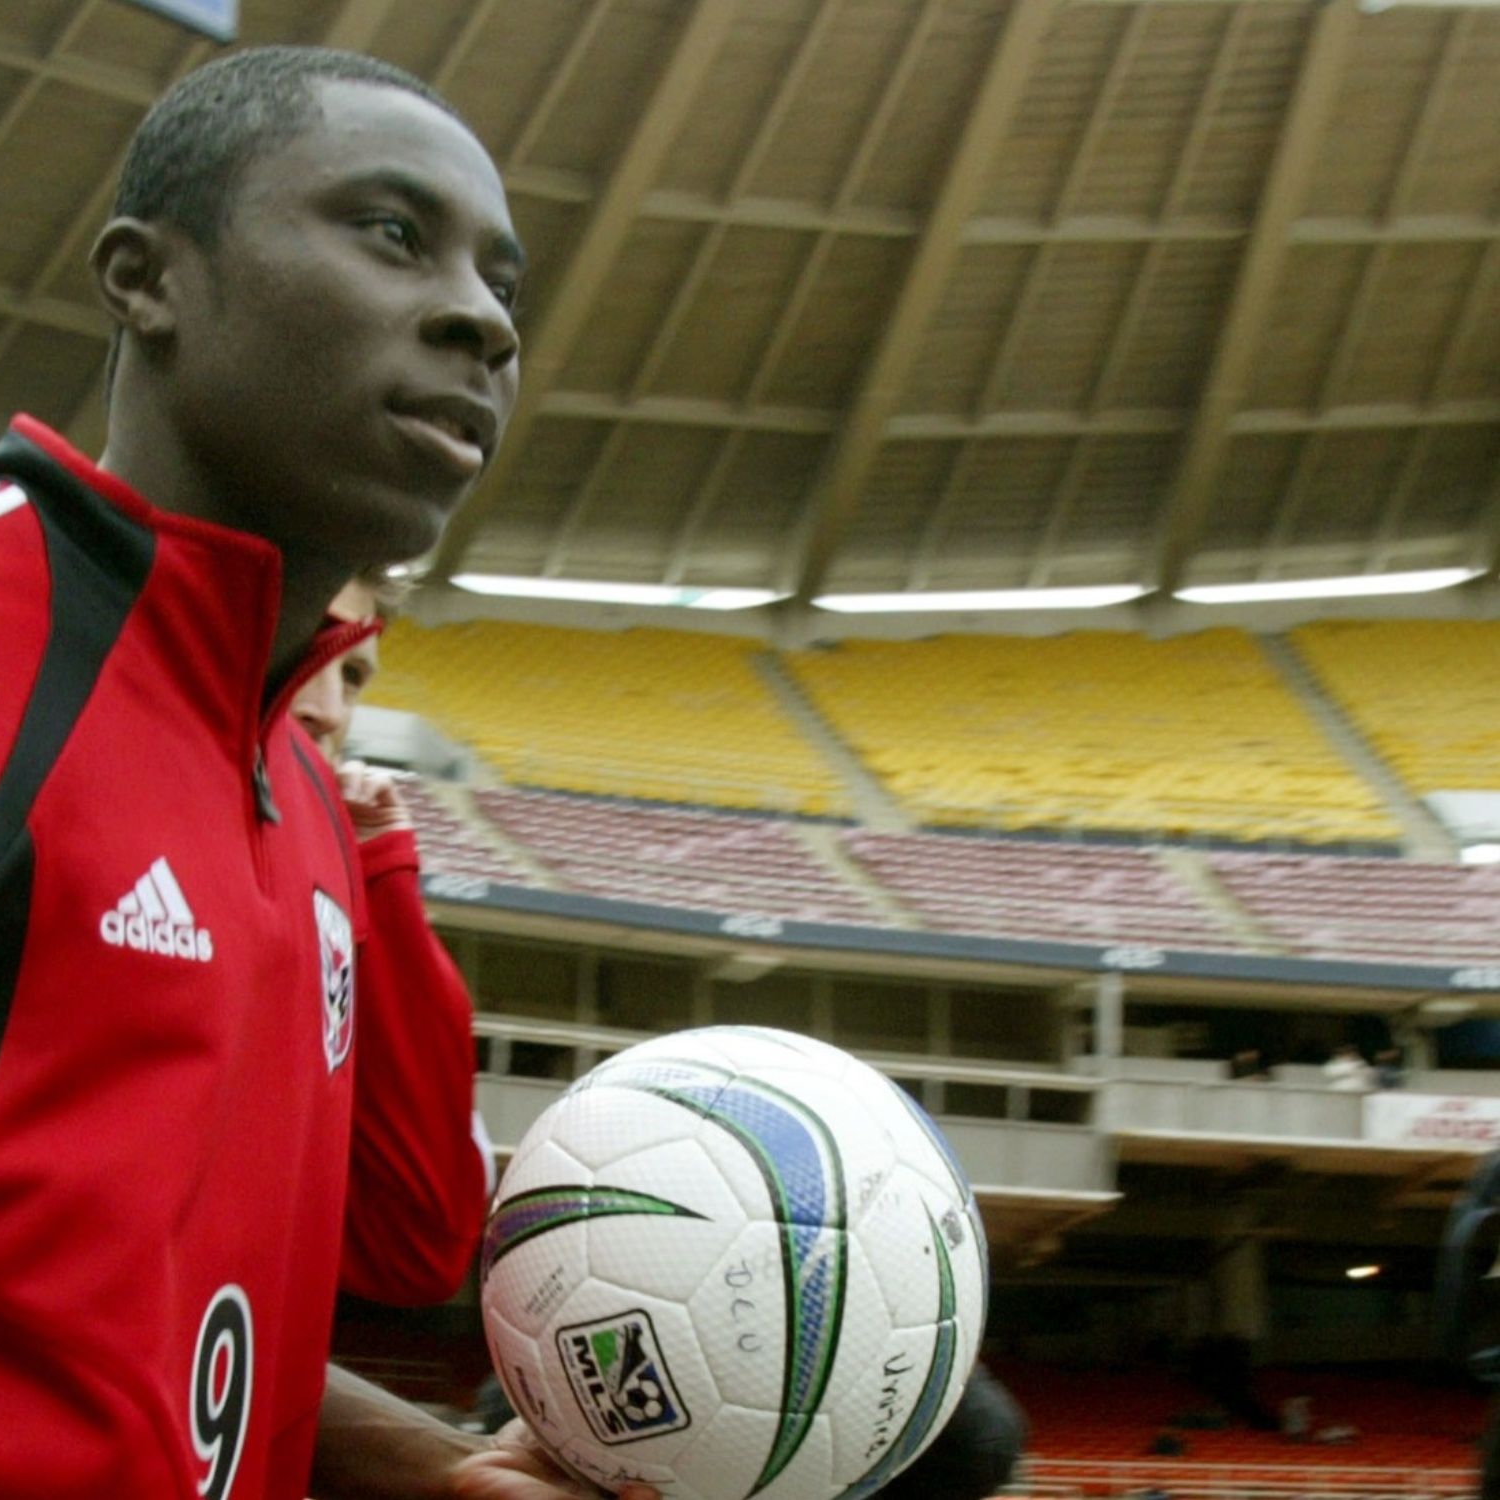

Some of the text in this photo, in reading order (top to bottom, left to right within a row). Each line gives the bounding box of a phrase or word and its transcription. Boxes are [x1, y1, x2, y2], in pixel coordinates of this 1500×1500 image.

[100, 909, 213, 963] adidas
[189, 1283, 254, 1500] 9
[571, 1335, 626, 1435] MLS
